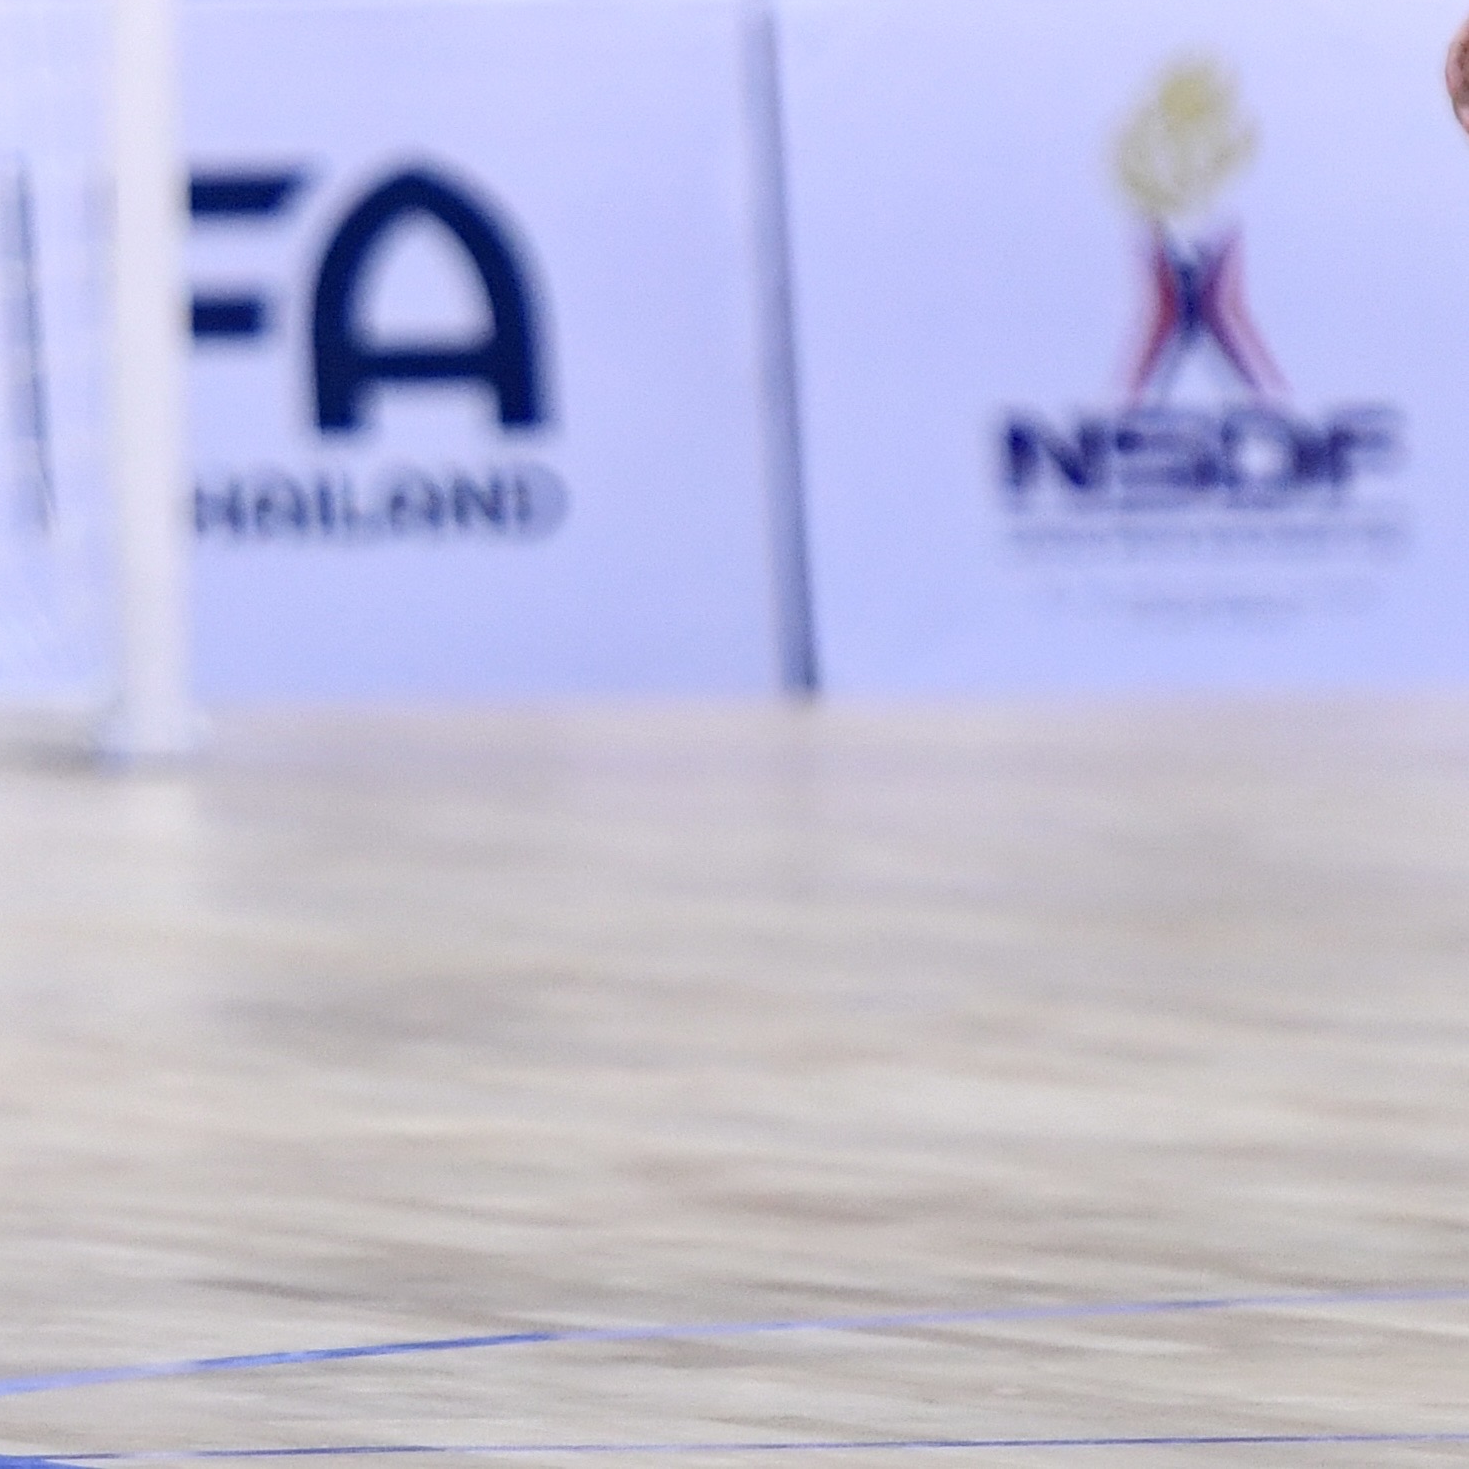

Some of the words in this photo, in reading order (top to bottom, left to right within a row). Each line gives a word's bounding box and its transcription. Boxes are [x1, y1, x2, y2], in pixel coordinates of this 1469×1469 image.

[190, 171, 542, 431] FA
[190, 469, 568, 535] HAILAND
[1006, 411, 1400, 507] NSDF
